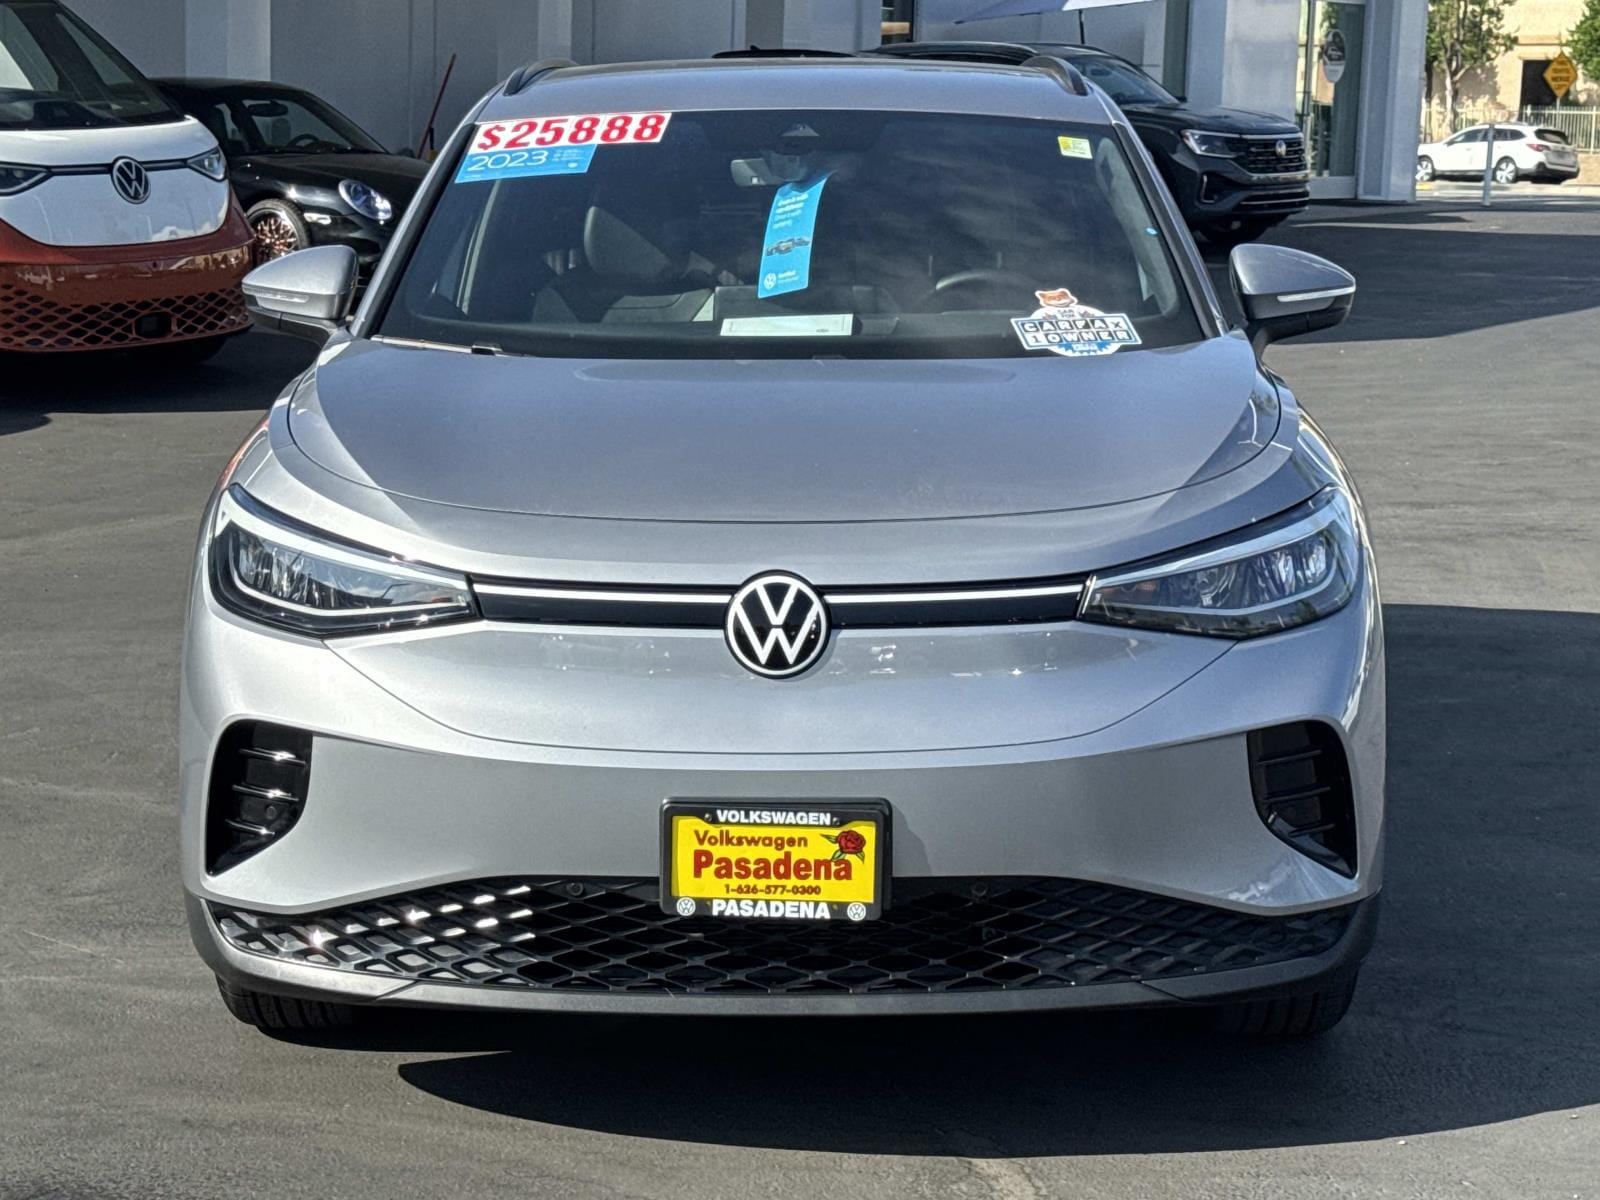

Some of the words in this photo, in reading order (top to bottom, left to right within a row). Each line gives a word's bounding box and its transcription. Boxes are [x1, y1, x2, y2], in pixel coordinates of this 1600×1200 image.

[477, 113, 666, 150] $25888
[466, 150, 548, 171] 2023
[1023, 319, 1123, 332] CARFAX
[1030, 334, 1042, 343] 1
[1047, 330, 1132, 343] OWNER
[716, 810, 831, 826] VOLKSWAGEN
[694, 830, 808, 850] Volkswagen
[693, 850, 852, 880] Pasadena
[725, 884, 821, 895] 1-626-577-0300
[712, 899, 831, 919] PASADENA
